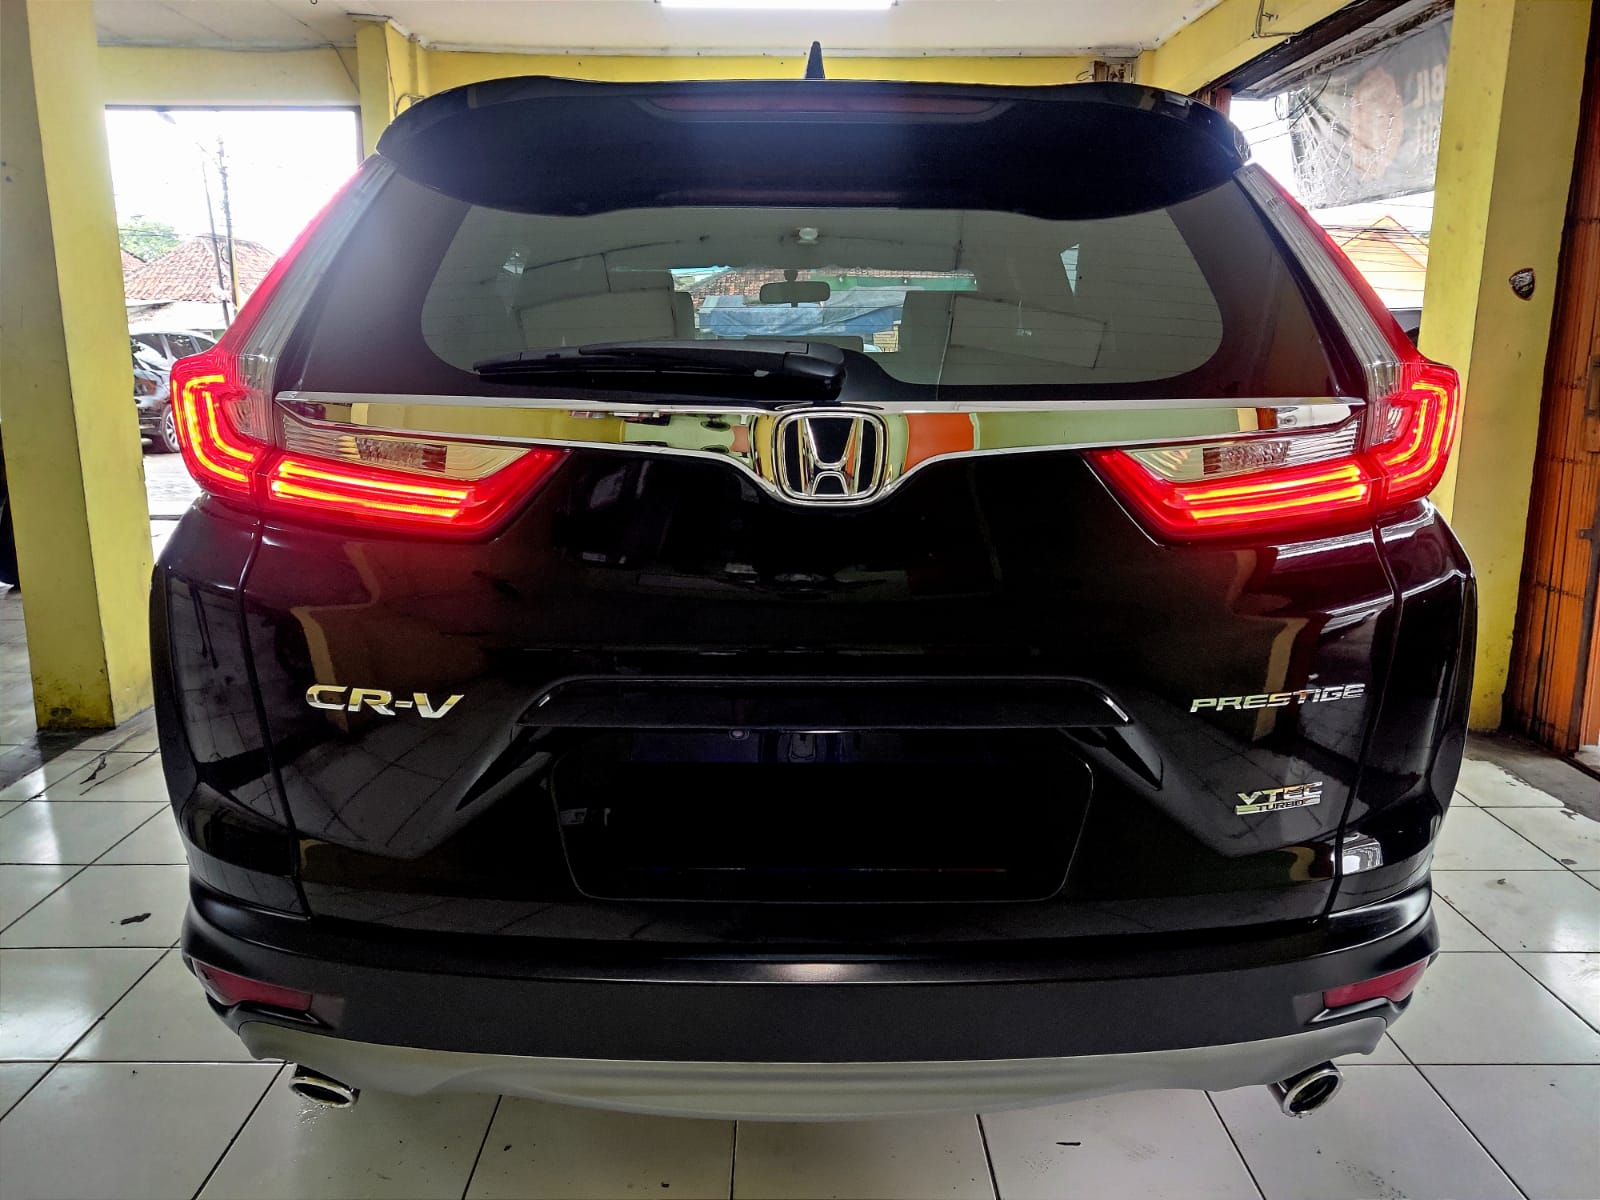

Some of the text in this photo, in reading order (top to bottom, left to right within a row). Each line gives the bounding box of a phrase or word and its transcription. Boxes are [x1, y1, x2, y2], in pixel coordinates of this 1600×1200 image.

[306, 684, 464, 718] CR-V
[1190, 683, 1365, 712] PRESTIGE
[1237, 781, 1323, 805] VTEC
[1257, 799, 1304, 811] TURBO
